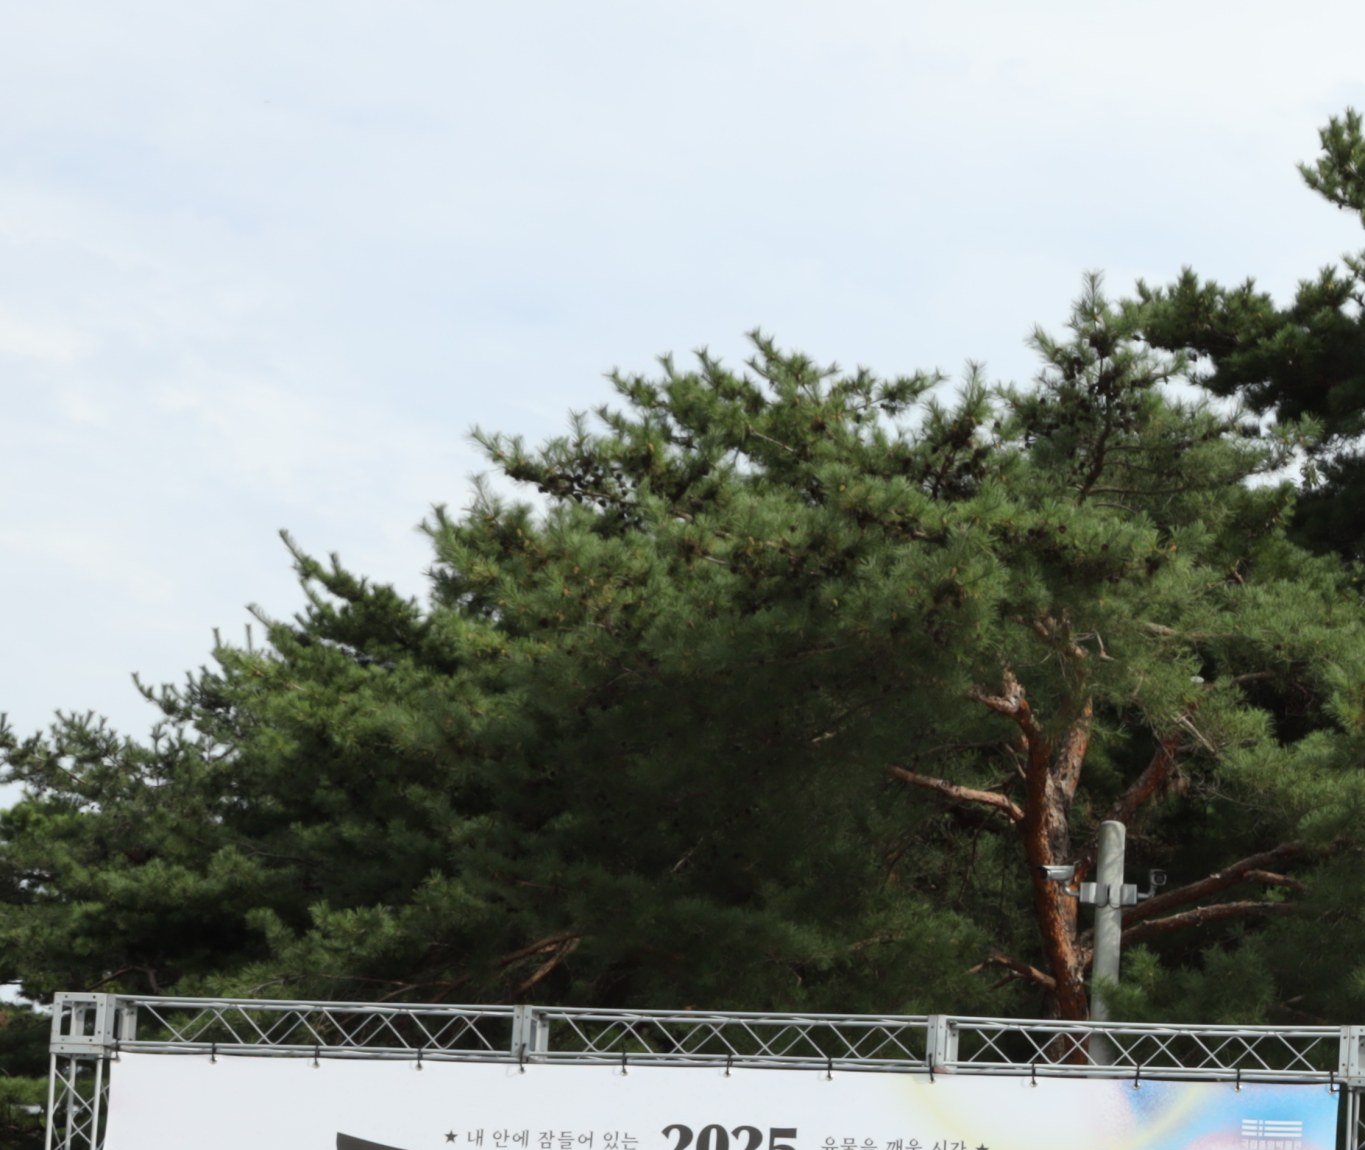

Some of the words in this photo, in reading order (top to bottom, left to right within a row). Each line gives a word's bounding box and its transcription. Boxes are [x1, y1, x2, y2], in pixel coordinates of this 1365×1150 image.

[467, 1129, 485, 1148] 내
[492, 1129, 530, 1149] 안에
[538, 1130, 594, 1150] 잠들어
